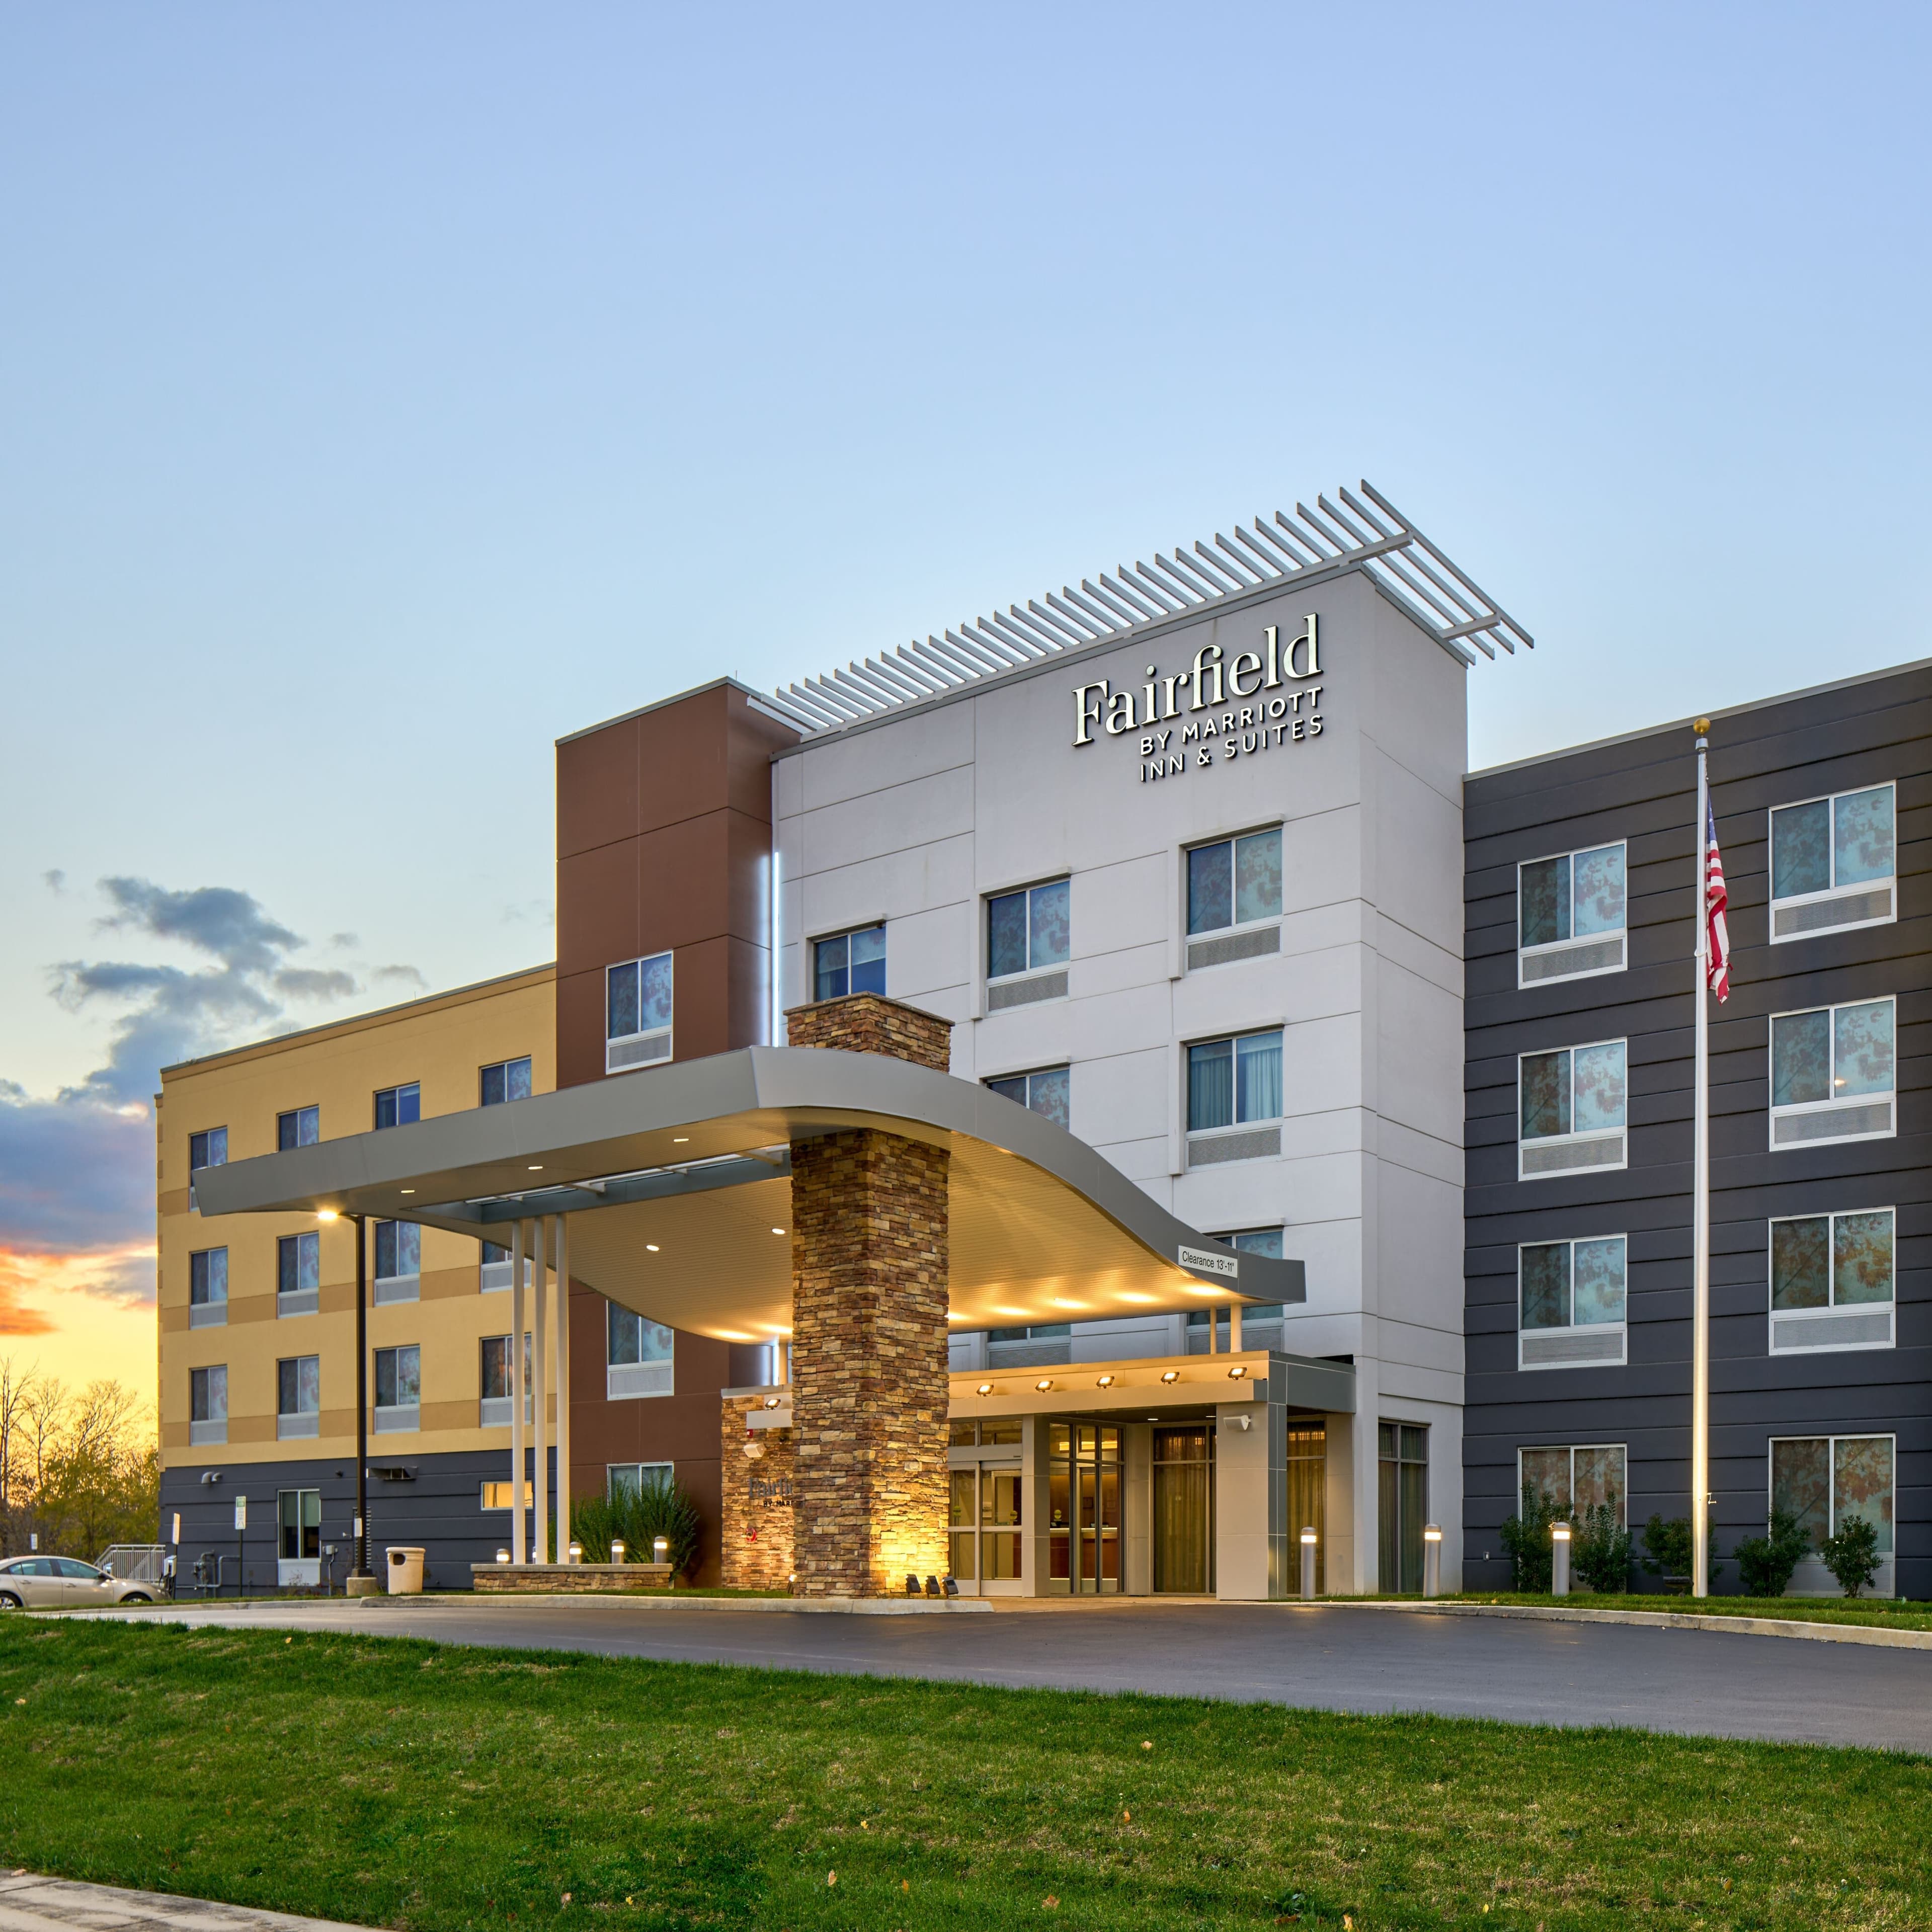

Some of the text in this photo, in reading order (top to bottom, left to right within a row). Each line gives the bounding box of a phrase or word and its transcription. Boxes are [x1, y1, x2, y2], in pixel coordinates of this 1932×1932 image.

[1072, 612, 1324, 748] Fairfield
[1140, 686, 1323, 756] BY MARRIOTT
[1140, 714, 1324, 782] INN & SUITES
[1182, 1251, 1215, 1268] Clearance
